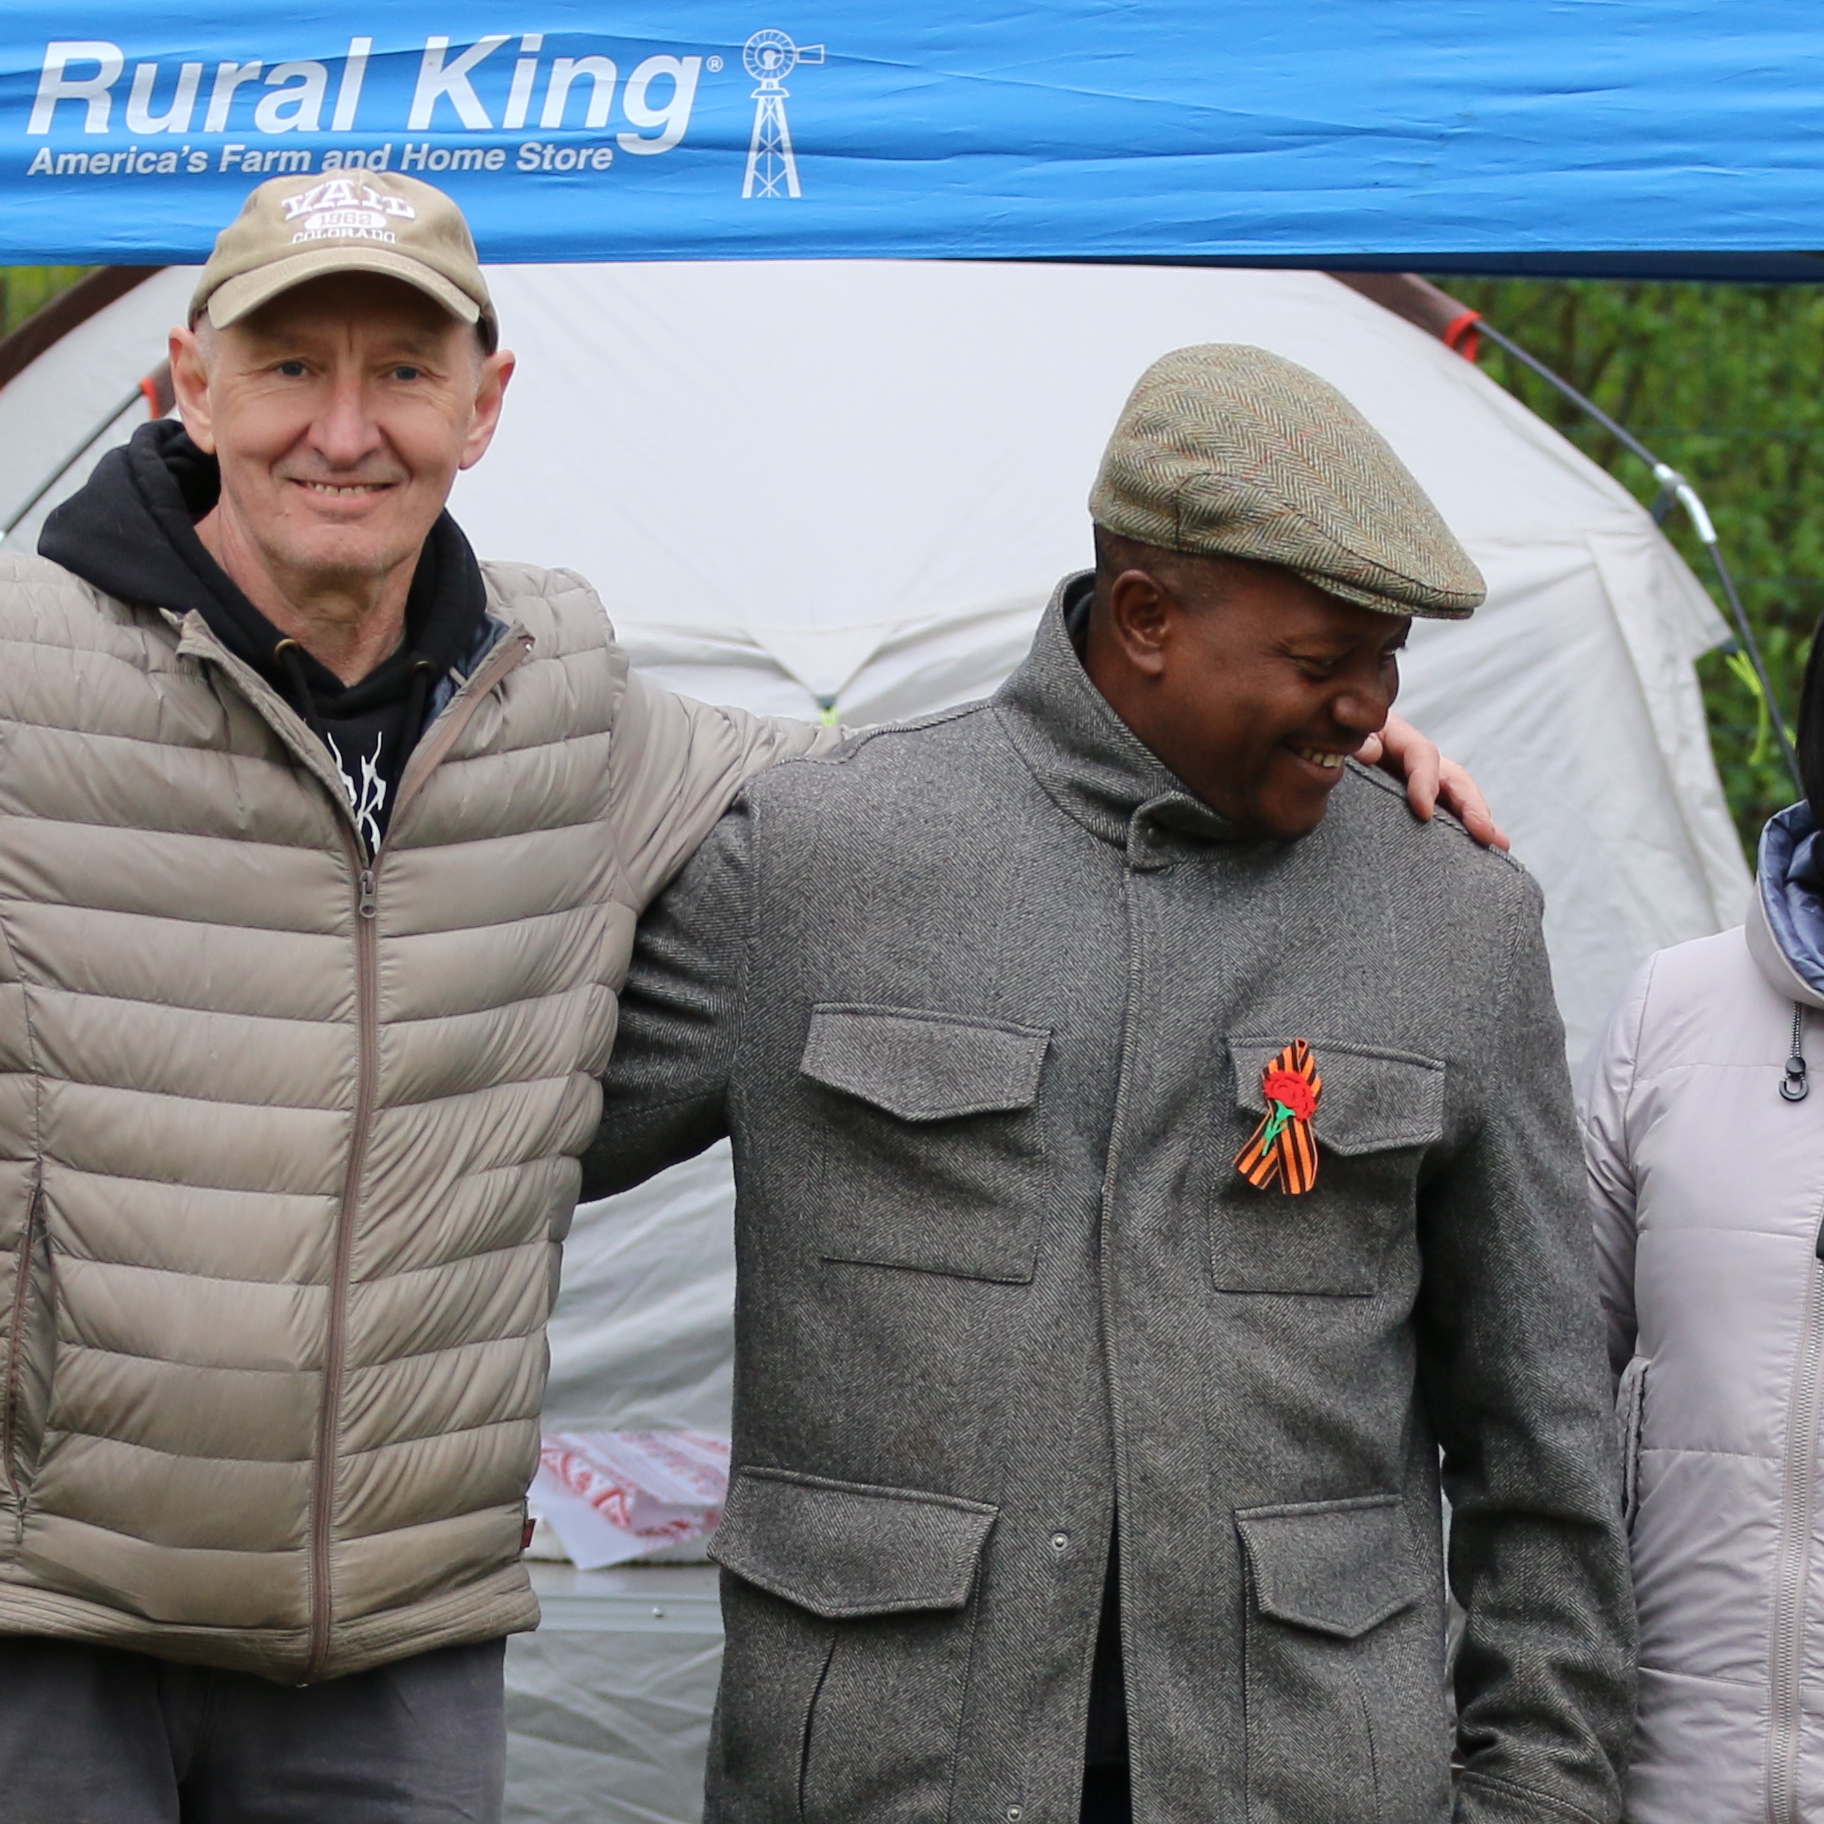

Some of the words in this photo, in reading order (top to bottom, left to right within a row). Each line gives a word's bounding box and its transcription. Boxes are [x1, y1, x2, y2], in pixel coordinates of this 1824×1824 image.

[26, 37, 373, 134] Rural
[407, 33, 702, 155] King
[26, 145, 208, 175] America's
[218, 144, 312, 173] Farm
[321, 142, 393, 170] and
[400, 142, 506, 171] Home
[516, 141, 613, 171] Store
[281, 179, 416, 221] VAIL
[291, 227, 396, 245] COLORADO
